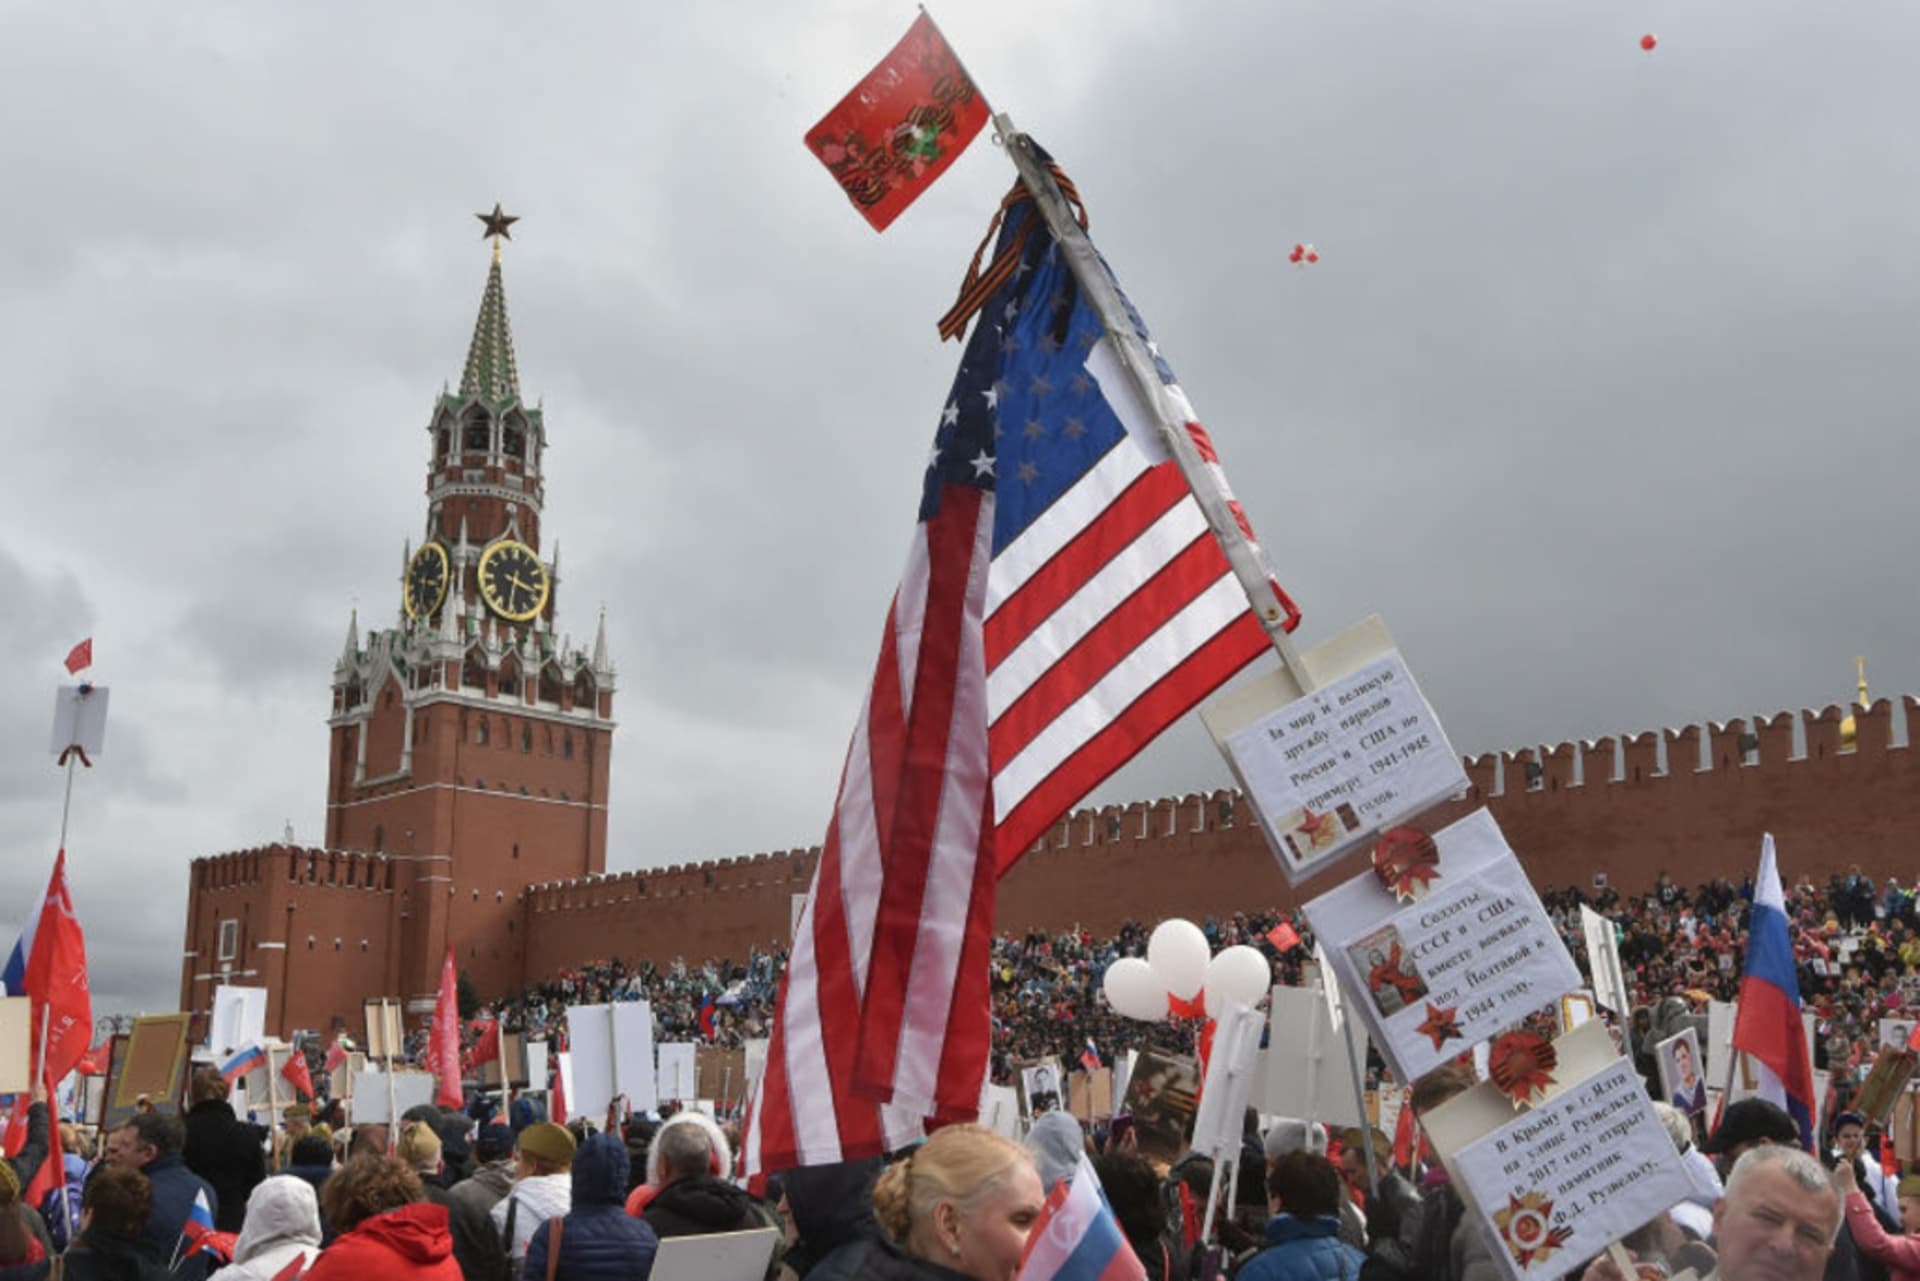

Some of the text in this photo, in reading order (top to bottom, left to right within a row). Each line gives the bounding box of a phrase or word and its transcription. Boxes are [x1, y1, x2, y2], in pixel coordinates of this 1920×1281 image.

[1269, 671, 1394, 741] За мир и великую
[1284, 697, 1391, 760] дружбу народов
[1343, 750, 1351, 760] и
[1359, 726, 1397, 750] США
[1308, 735, 1430, 812] примеру 1941-1945
[1409, 898, 1515, 960] СССР и США
[1420, 893, 1481, 929] Солдаты
[1427, 950, 1471, 979] вместе
[1464, 946, 1531, 988] Полтавой
[1536, 940, 1544, 948] в
[1465, 997, 1495, 1022] 1944
[1495, 1140, 1508, 1153] В
[1512, 1113, 1560, 1144] Крыму
[1565, 1104, 1574, 1114] в
[1514, 1110, 1645, 1195] в 2017 году открыт
[1503, 1160, 1520, 1174] на
[1526, 1132, 1566, 1163] улице
[1558, 1153, 1622, 1195] памятник
